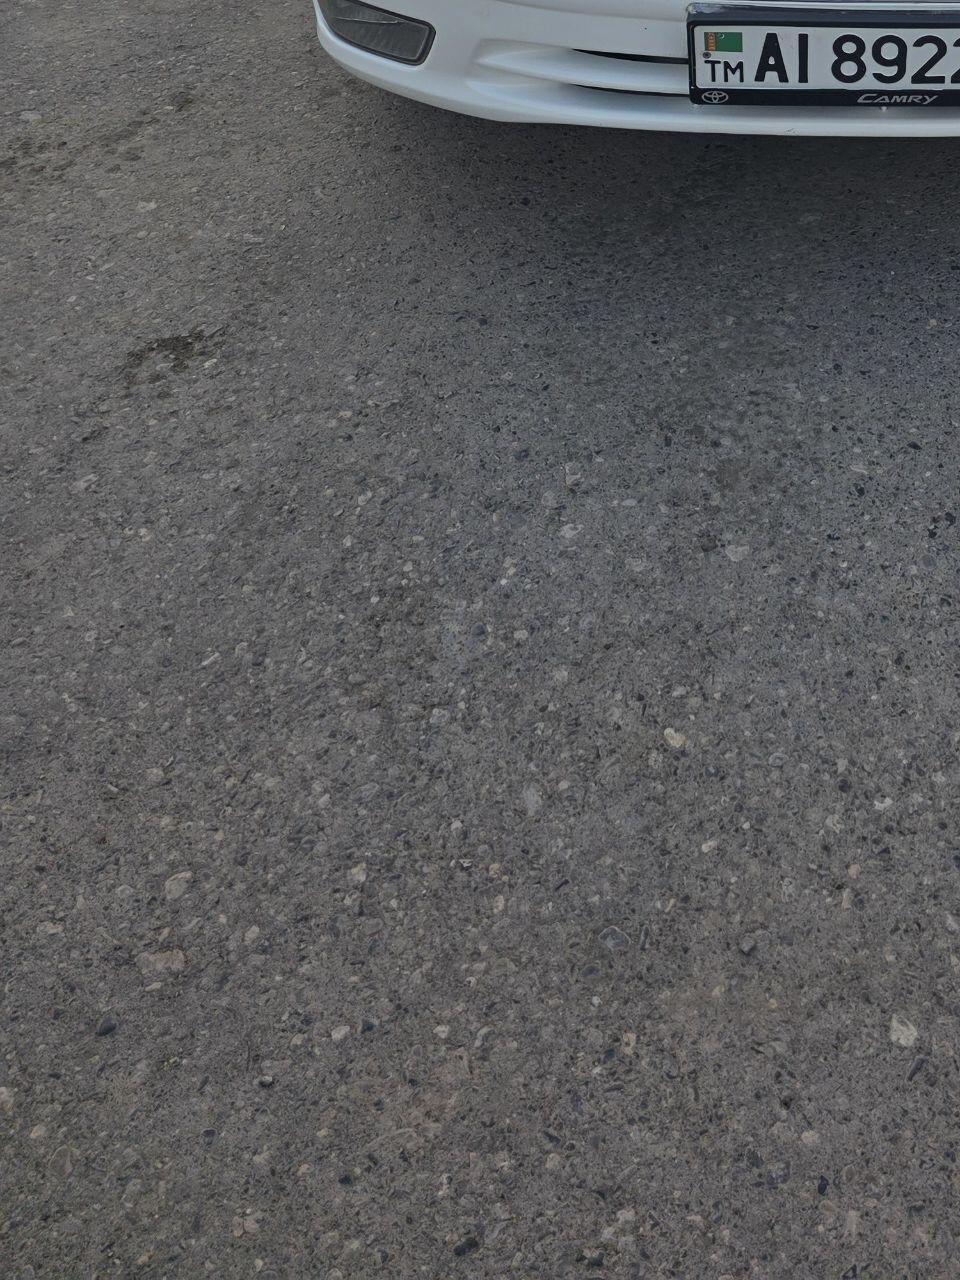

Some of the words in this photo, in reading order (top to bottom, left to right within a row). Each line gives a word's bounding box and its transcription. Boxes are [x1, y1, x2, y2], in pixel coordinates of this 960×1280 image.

[703, 59, 745, 83] TM
[753, 32, 809, 84] AI
[856, 93, 939, 105] CAMRY
